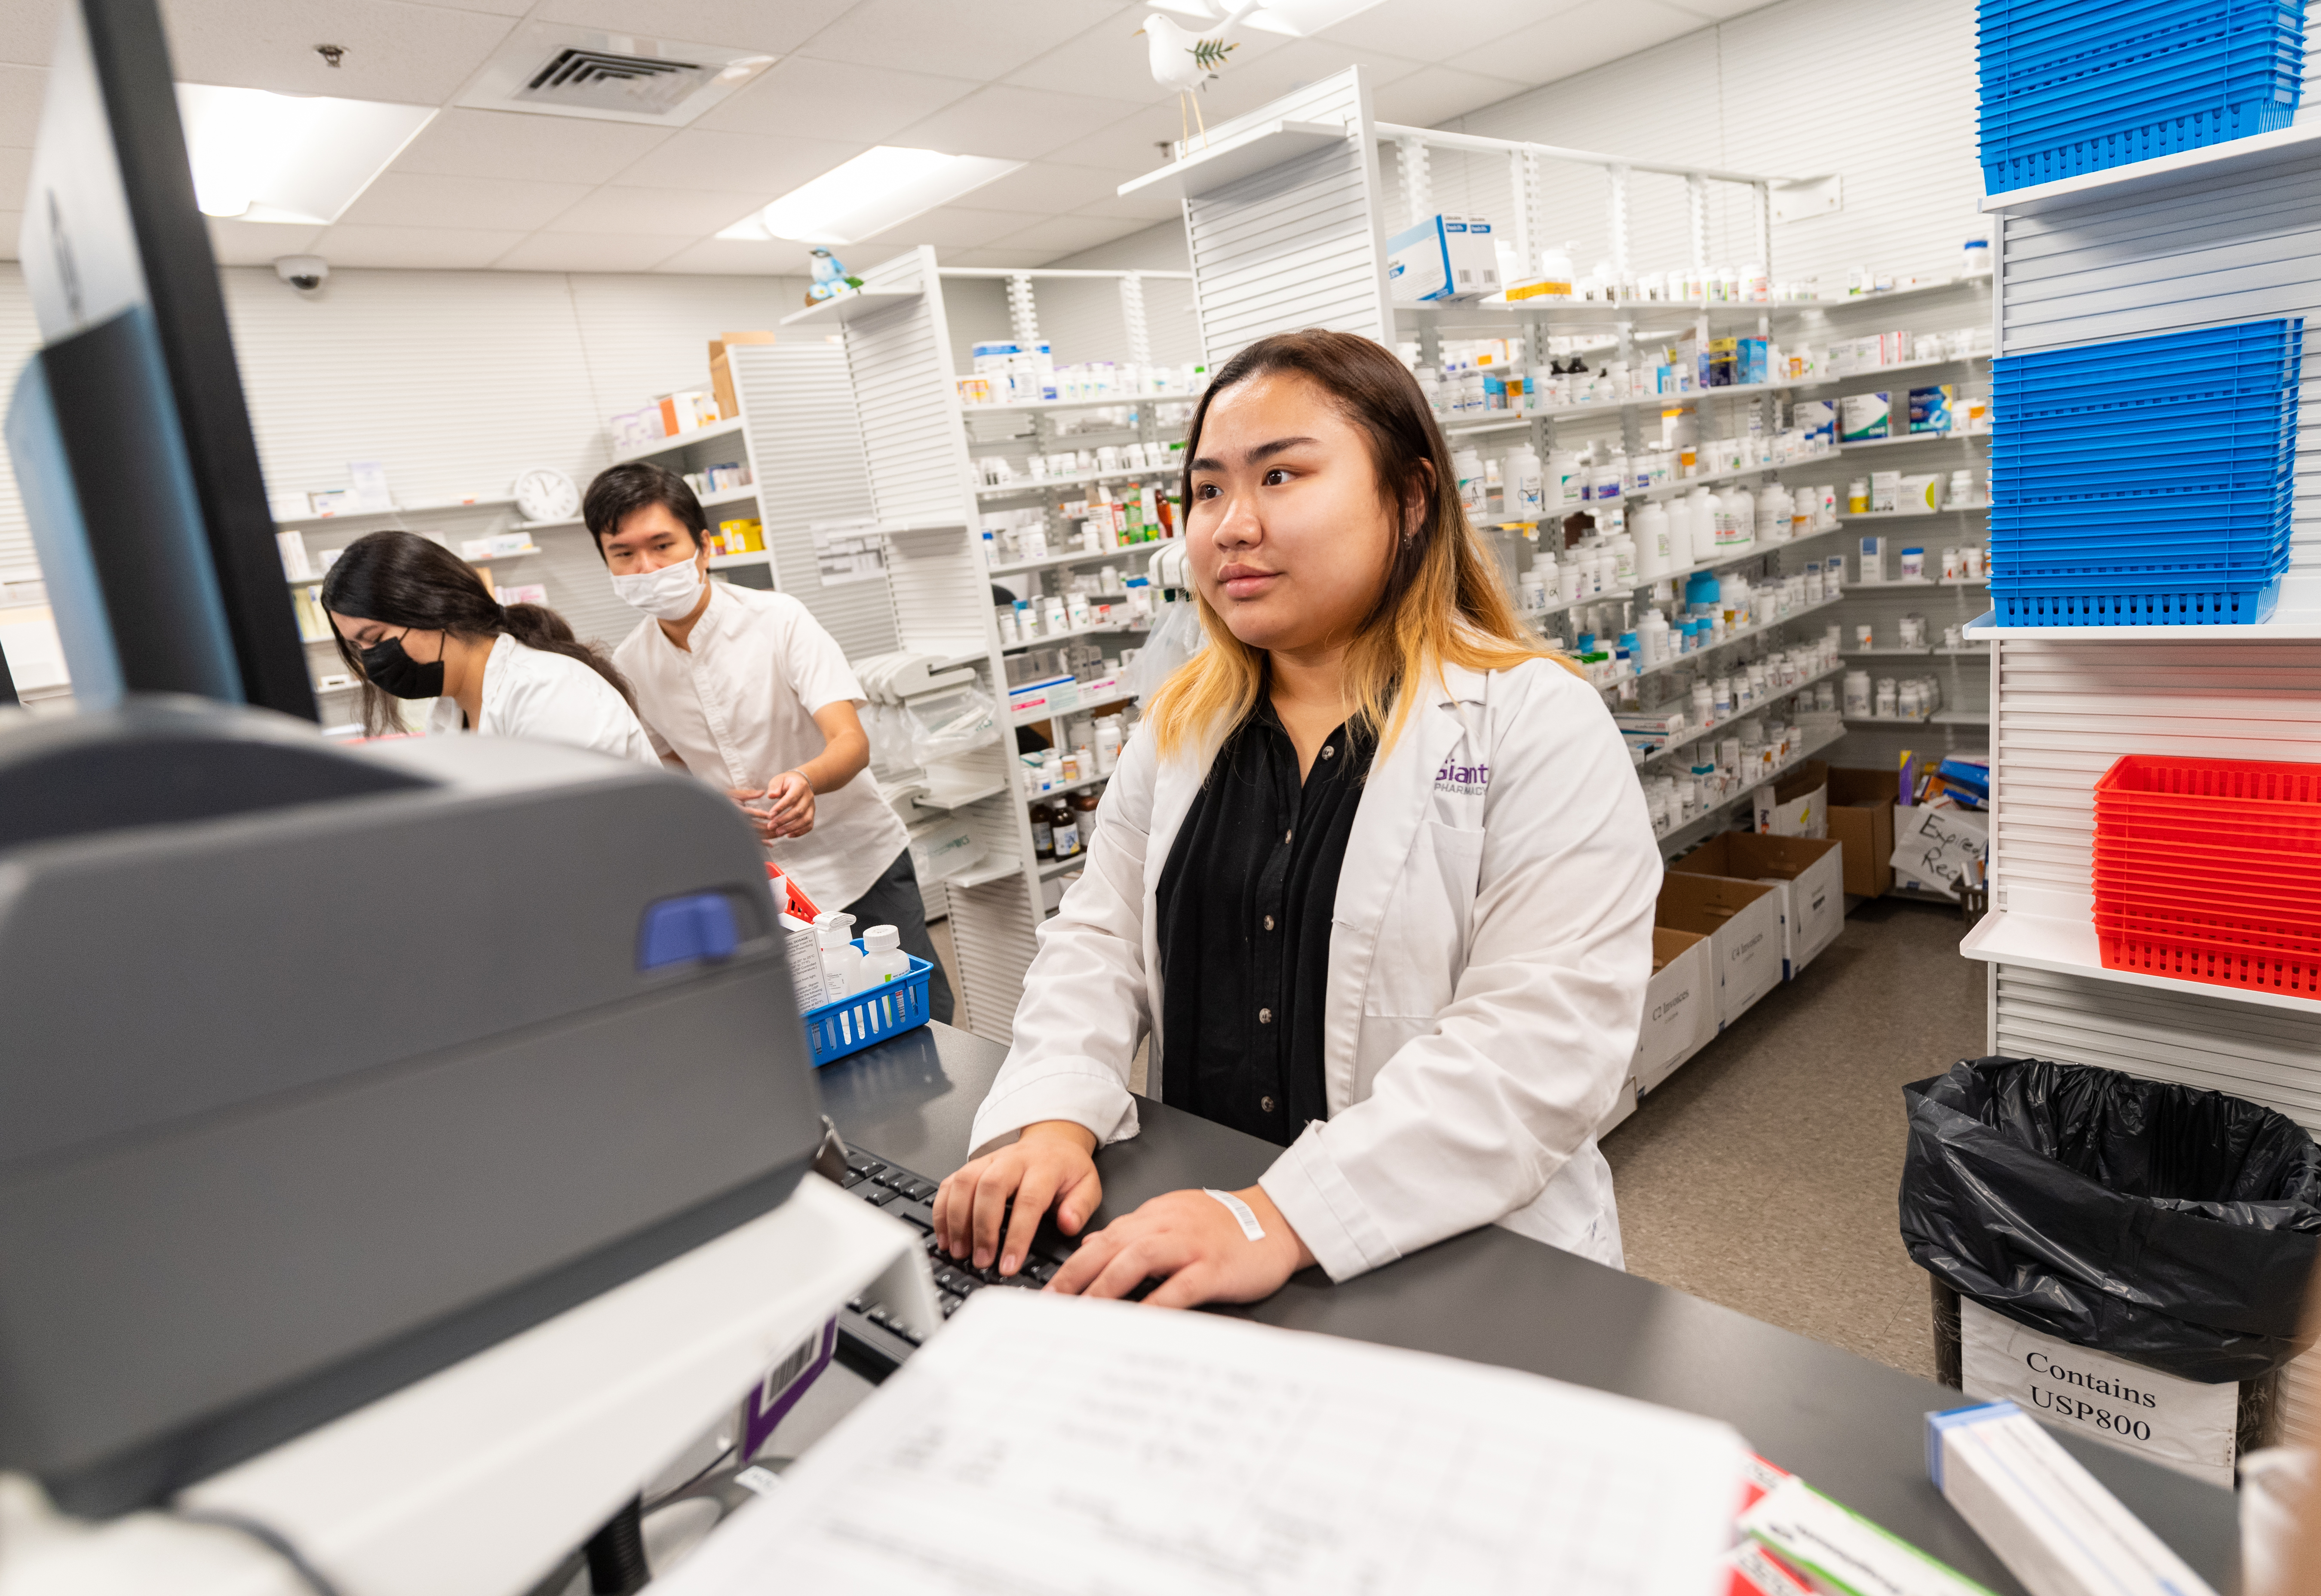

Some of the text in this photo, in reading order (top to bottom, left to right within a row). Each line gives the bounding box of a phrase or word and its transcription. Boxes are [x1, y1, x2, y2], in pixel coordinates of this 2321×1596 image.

[796, 943, 813, 951] Prescribing
[1663, 989, 1689, 1014] Invoices
[2026, 1352, 2156, 1408] Contains
[2029, 1384, 2150, 1440] USP800
